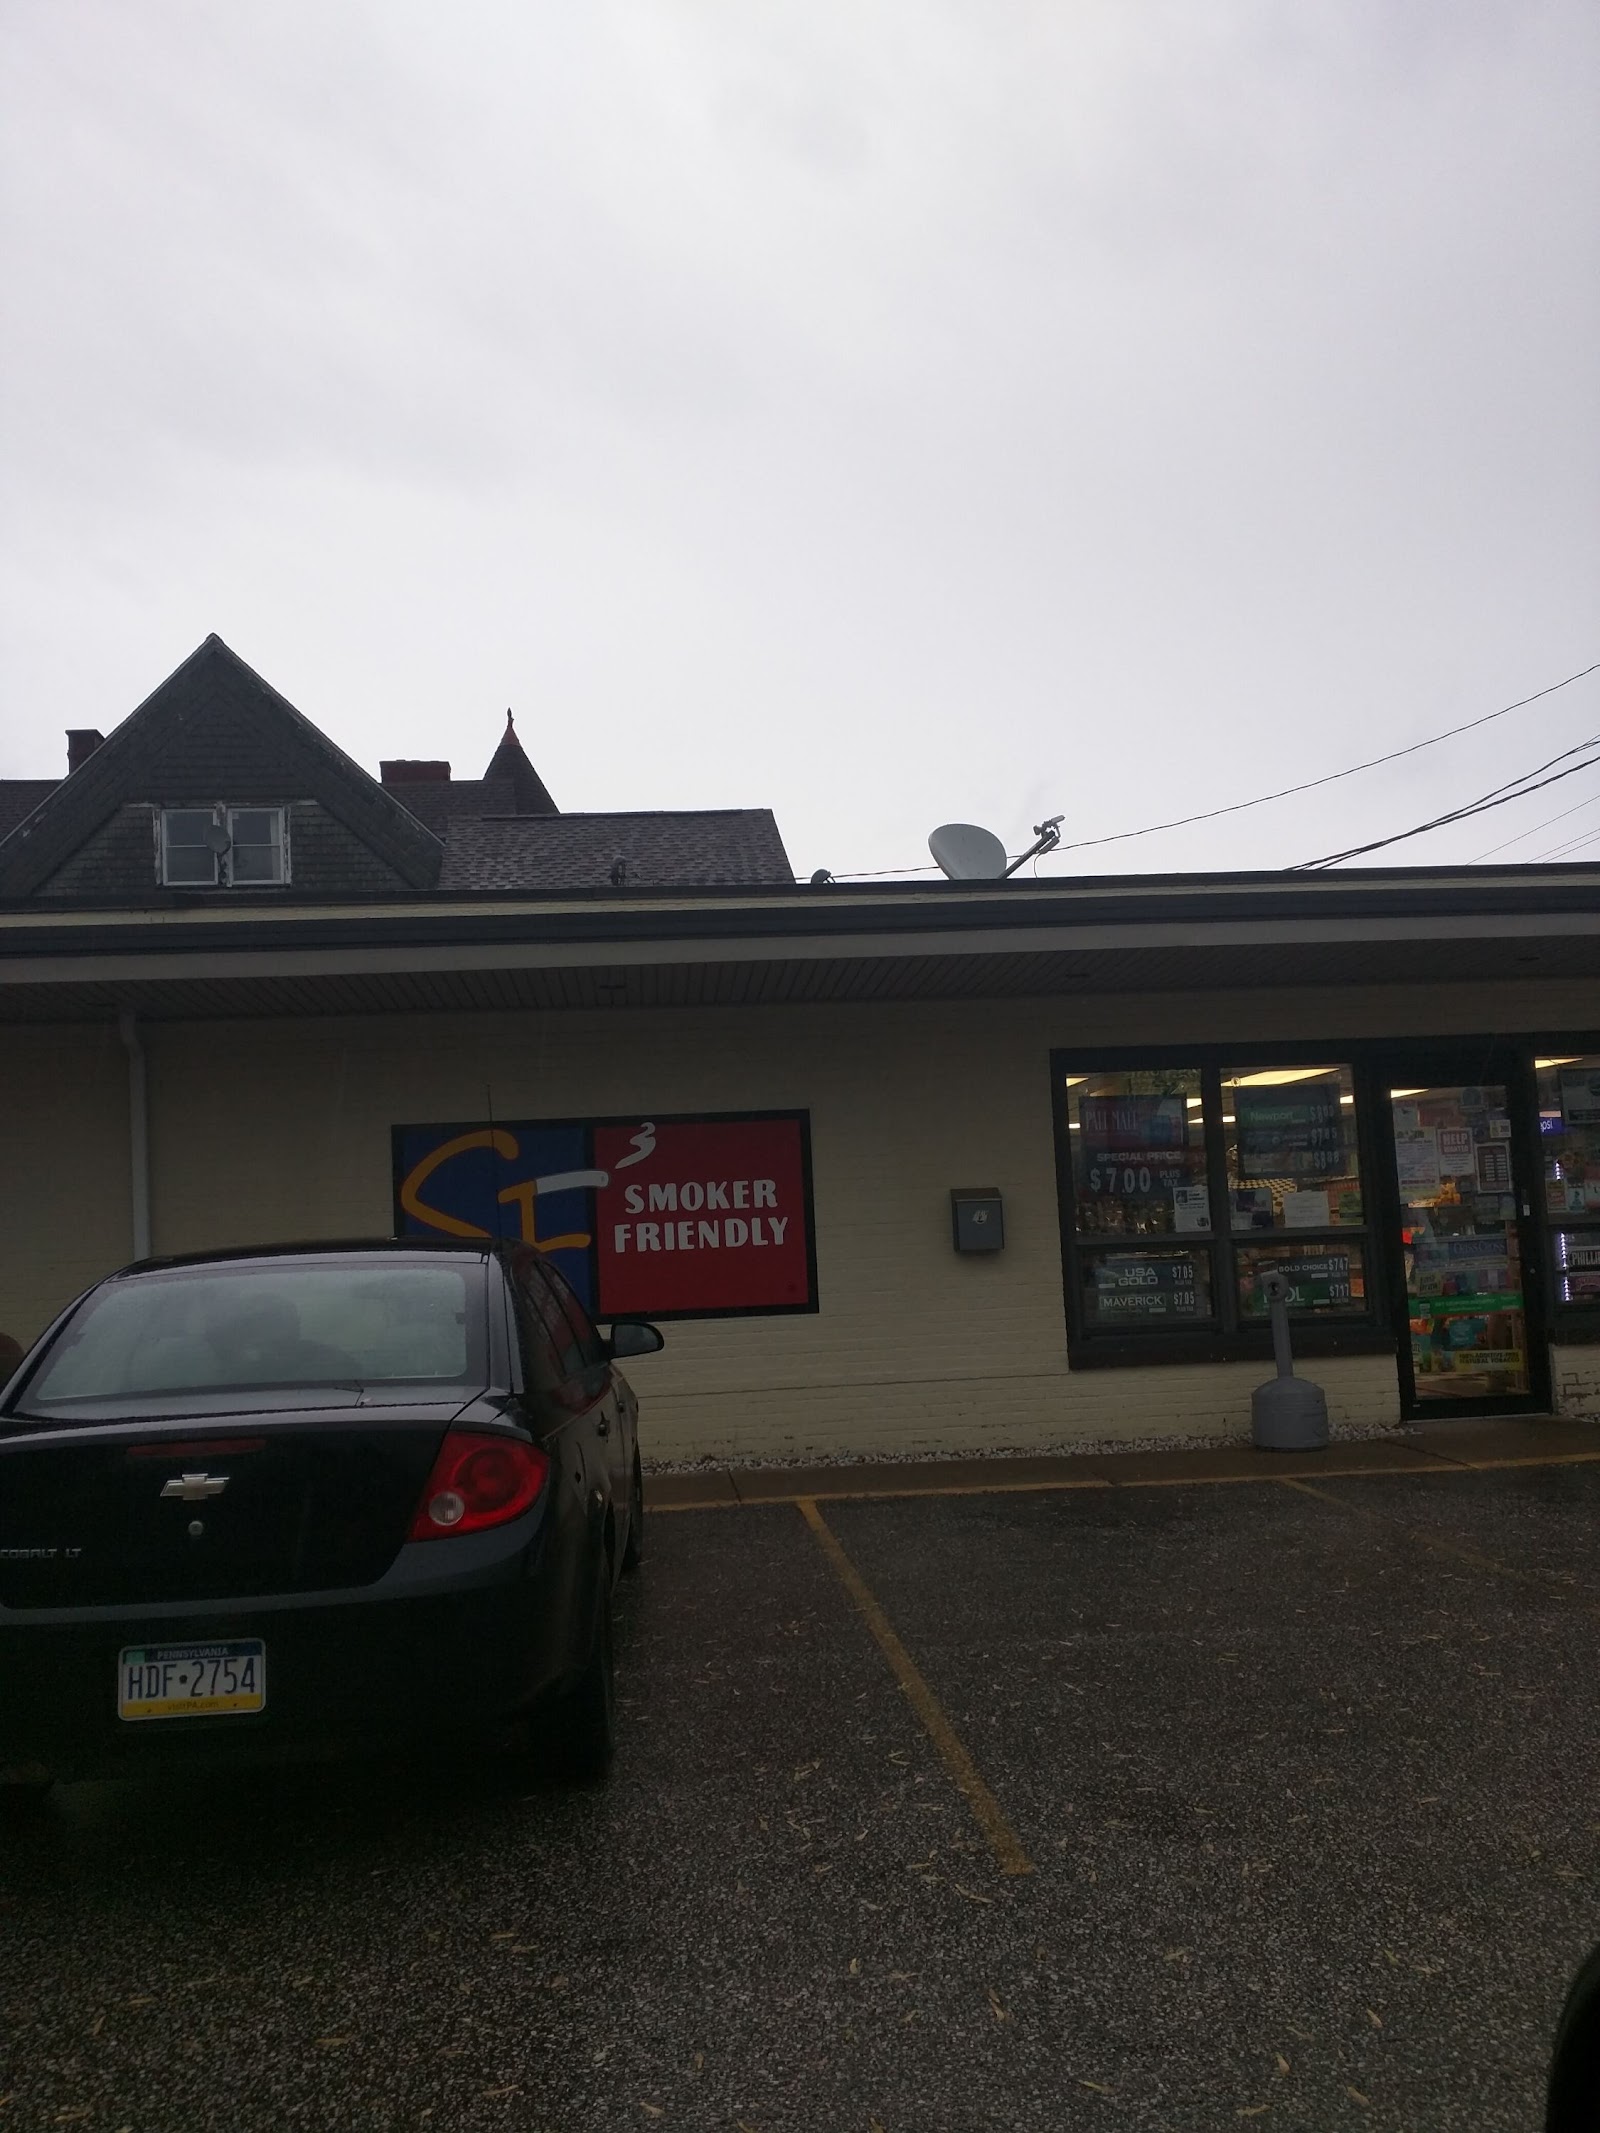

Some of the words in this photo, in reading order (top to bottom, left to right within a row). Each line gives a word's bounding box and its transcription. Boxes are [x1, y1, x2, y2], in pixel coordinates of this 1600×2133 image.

[1250, 1112, 1294, 1121] Newport
[1443, 1133, 1468, 1145] HELP
[1096, 1152, 1142, 1162] SPECIAL
[1146, 1151, 1182, 1161] PRICE
[1159, 1170, 1181, 1178] PLUS
[1163, 1178, 1178, 1187] TAX
[624, 1179, 779, 1214] SMOKER
[614, 1217, 789, 1254] FRIENDLY
[1124, 1267, 1157, 1277] USA
[1118, 1276, 1159, 1287] GOLD
[1103, 1295, 1163, 1308] MAVERICK
[157, 1646, 230, 1660] PENNSYLVANIA
